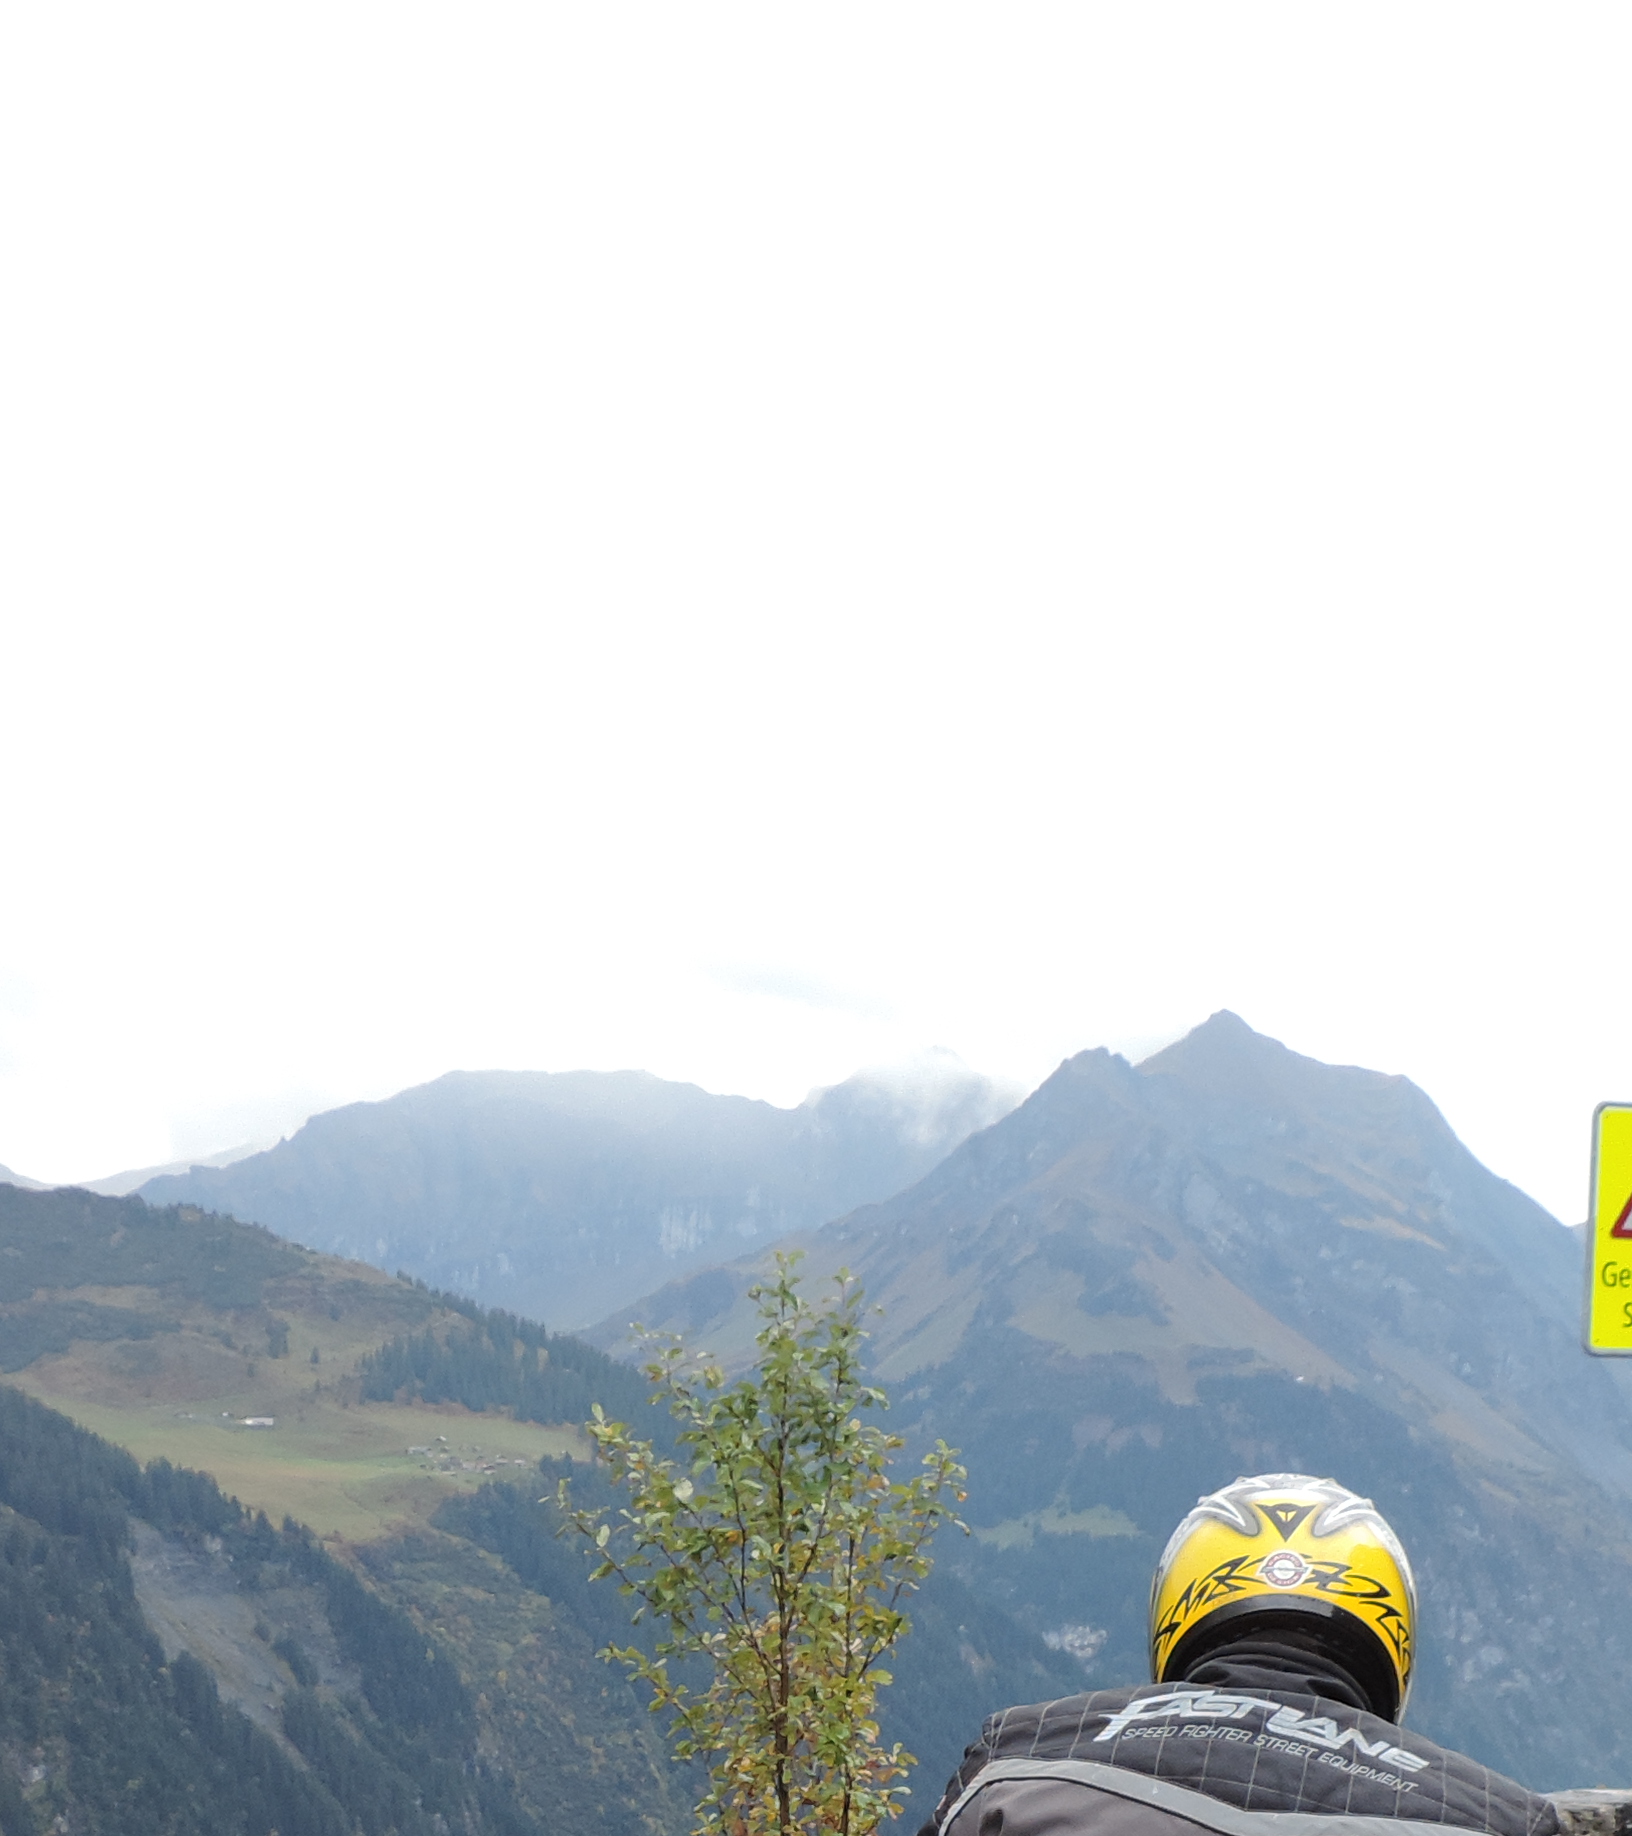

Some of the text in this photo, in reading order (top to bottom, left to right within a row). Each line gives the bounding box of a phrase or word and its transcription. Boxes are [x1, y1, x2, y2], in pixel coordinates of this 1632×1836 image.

[1093, 1689, 1431, 1773] FAST LANE
[1121, 1723, 1419, 1794] SPEED FIGHTER STREET EQUIPMENT
